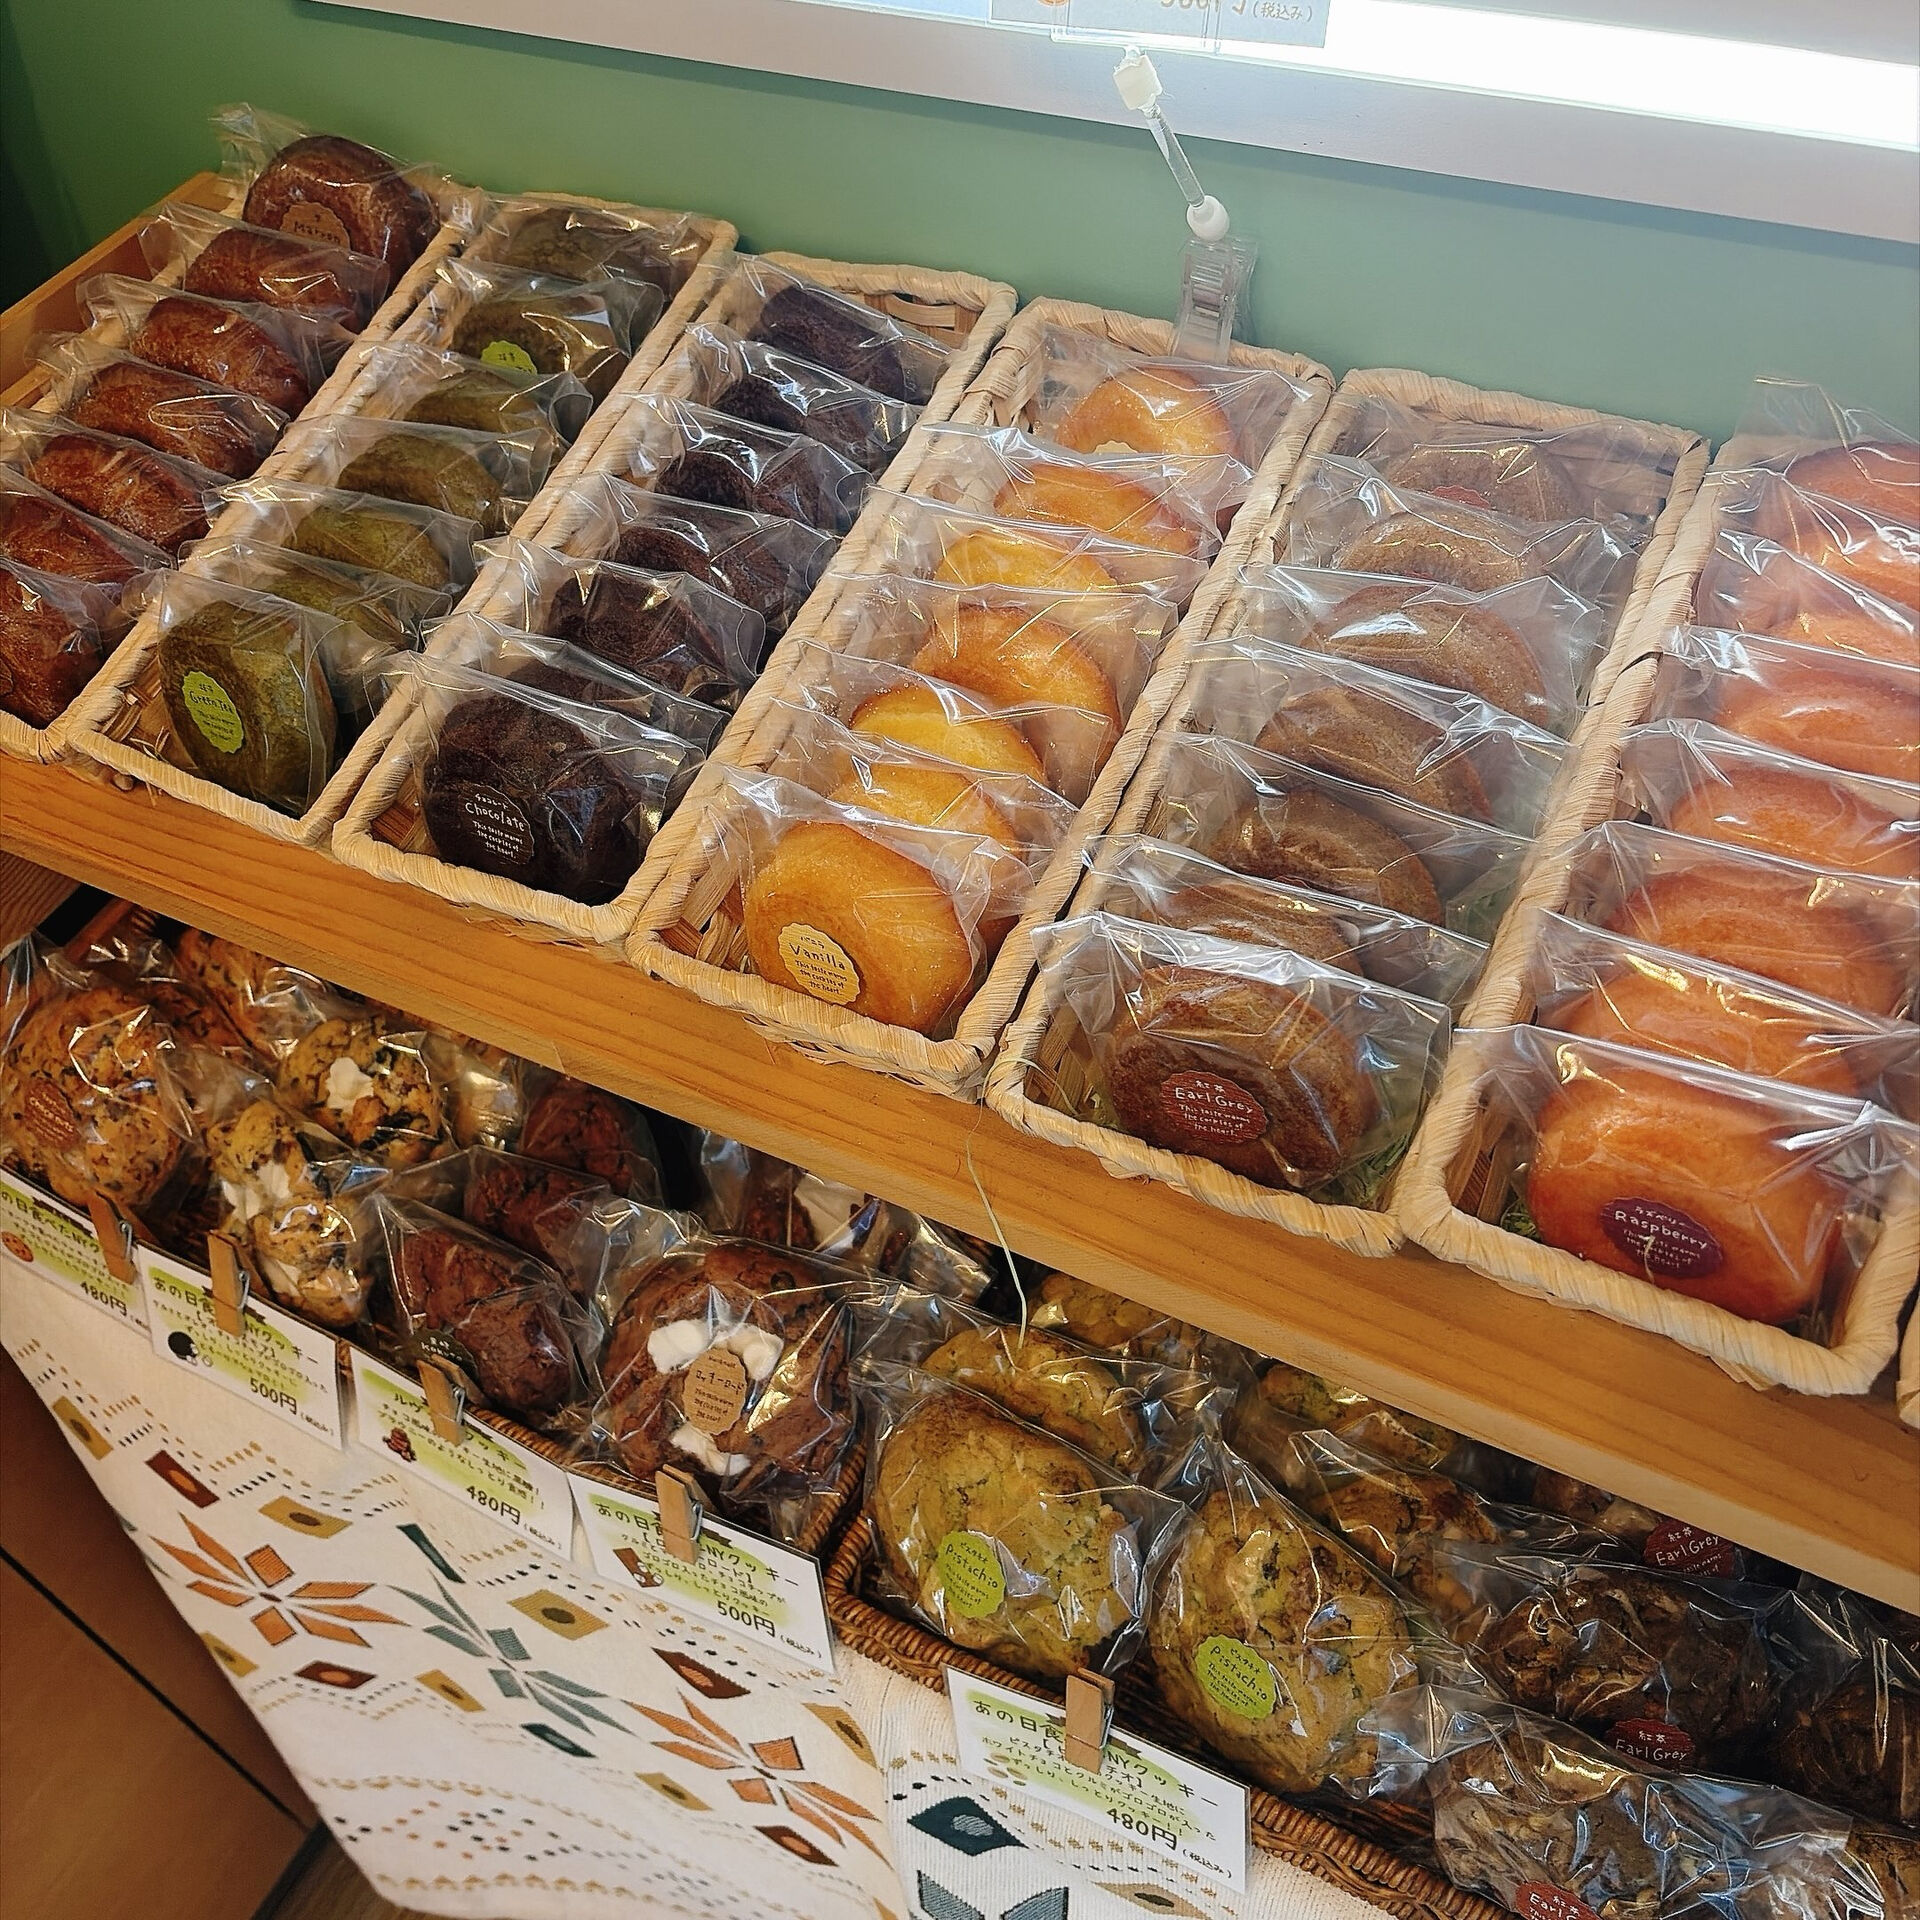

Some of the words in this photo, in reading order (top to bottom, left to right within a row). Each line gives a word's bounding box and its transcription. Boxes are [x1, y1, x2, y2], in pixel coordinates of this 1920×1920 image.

[465, 802, 525, 832] Chocolate
[472, 820, 487, 831] This
[487, 825, 504, 837] taste
[476, 829, 488, 839] the
[485, 841, 497, 850] the
[789, 942, 846, 970] Vanilla
[795, 959, 810, 969] This
[810, 964, 828, 976] taste
[809, 980, 821, 989] the
[1195, 1079, 1226, 1093] 紅茶
[1175, 1087, 1211, 1103] Earl
[1215, 1095, 1253, 1114] Grey
[1179, 1103, 1199, 1113] This
[1201, 1107, 1222, 1118] taste
[1221, 1112, 1251, 1124] warms
[1184, 1112, 1197, 1121] the
[1233, 1122, 1244, 1132] of
[1194, 1122, 1208, 1132] the
[1614, 1209, 1708, 1250] Raspberry
[81, 1281, 128, 1317] 480円
[696, 1369, 745, 1396] ロッキーロード
[249, 1377, 298, 1416] 500円
[465, 1485, 522, 1526] 480円
[1667, 1526, 1692, 1543] 紅茶
[1655, 1544, 1688, 1567] Earl
[1688, 1536, 1719, 1555] Grey
[946, 1543, 998, 1588] Pistachio
[717, 1600, 776, 1638] 500円
[780, 1634, 822, 1659] (税込み)
[1210, 1645, 1268, 1700] Pistachio
[1230, 1648, 1261, 1675] ピスタチオ
[1615, 1739, 1649, 1758] Earl
[1652, 1748, 1687, 1761] Grey
[1638, 1730, 1667, 1744] 紅茶
[1107, 1807, 1178, 1851] 480円
[1182, 1848, 1232, 1879] (税込み)
[1529, 1892, 1562, 1918] Earl
[1552, 1896, 1580, 1917] 紅茶
